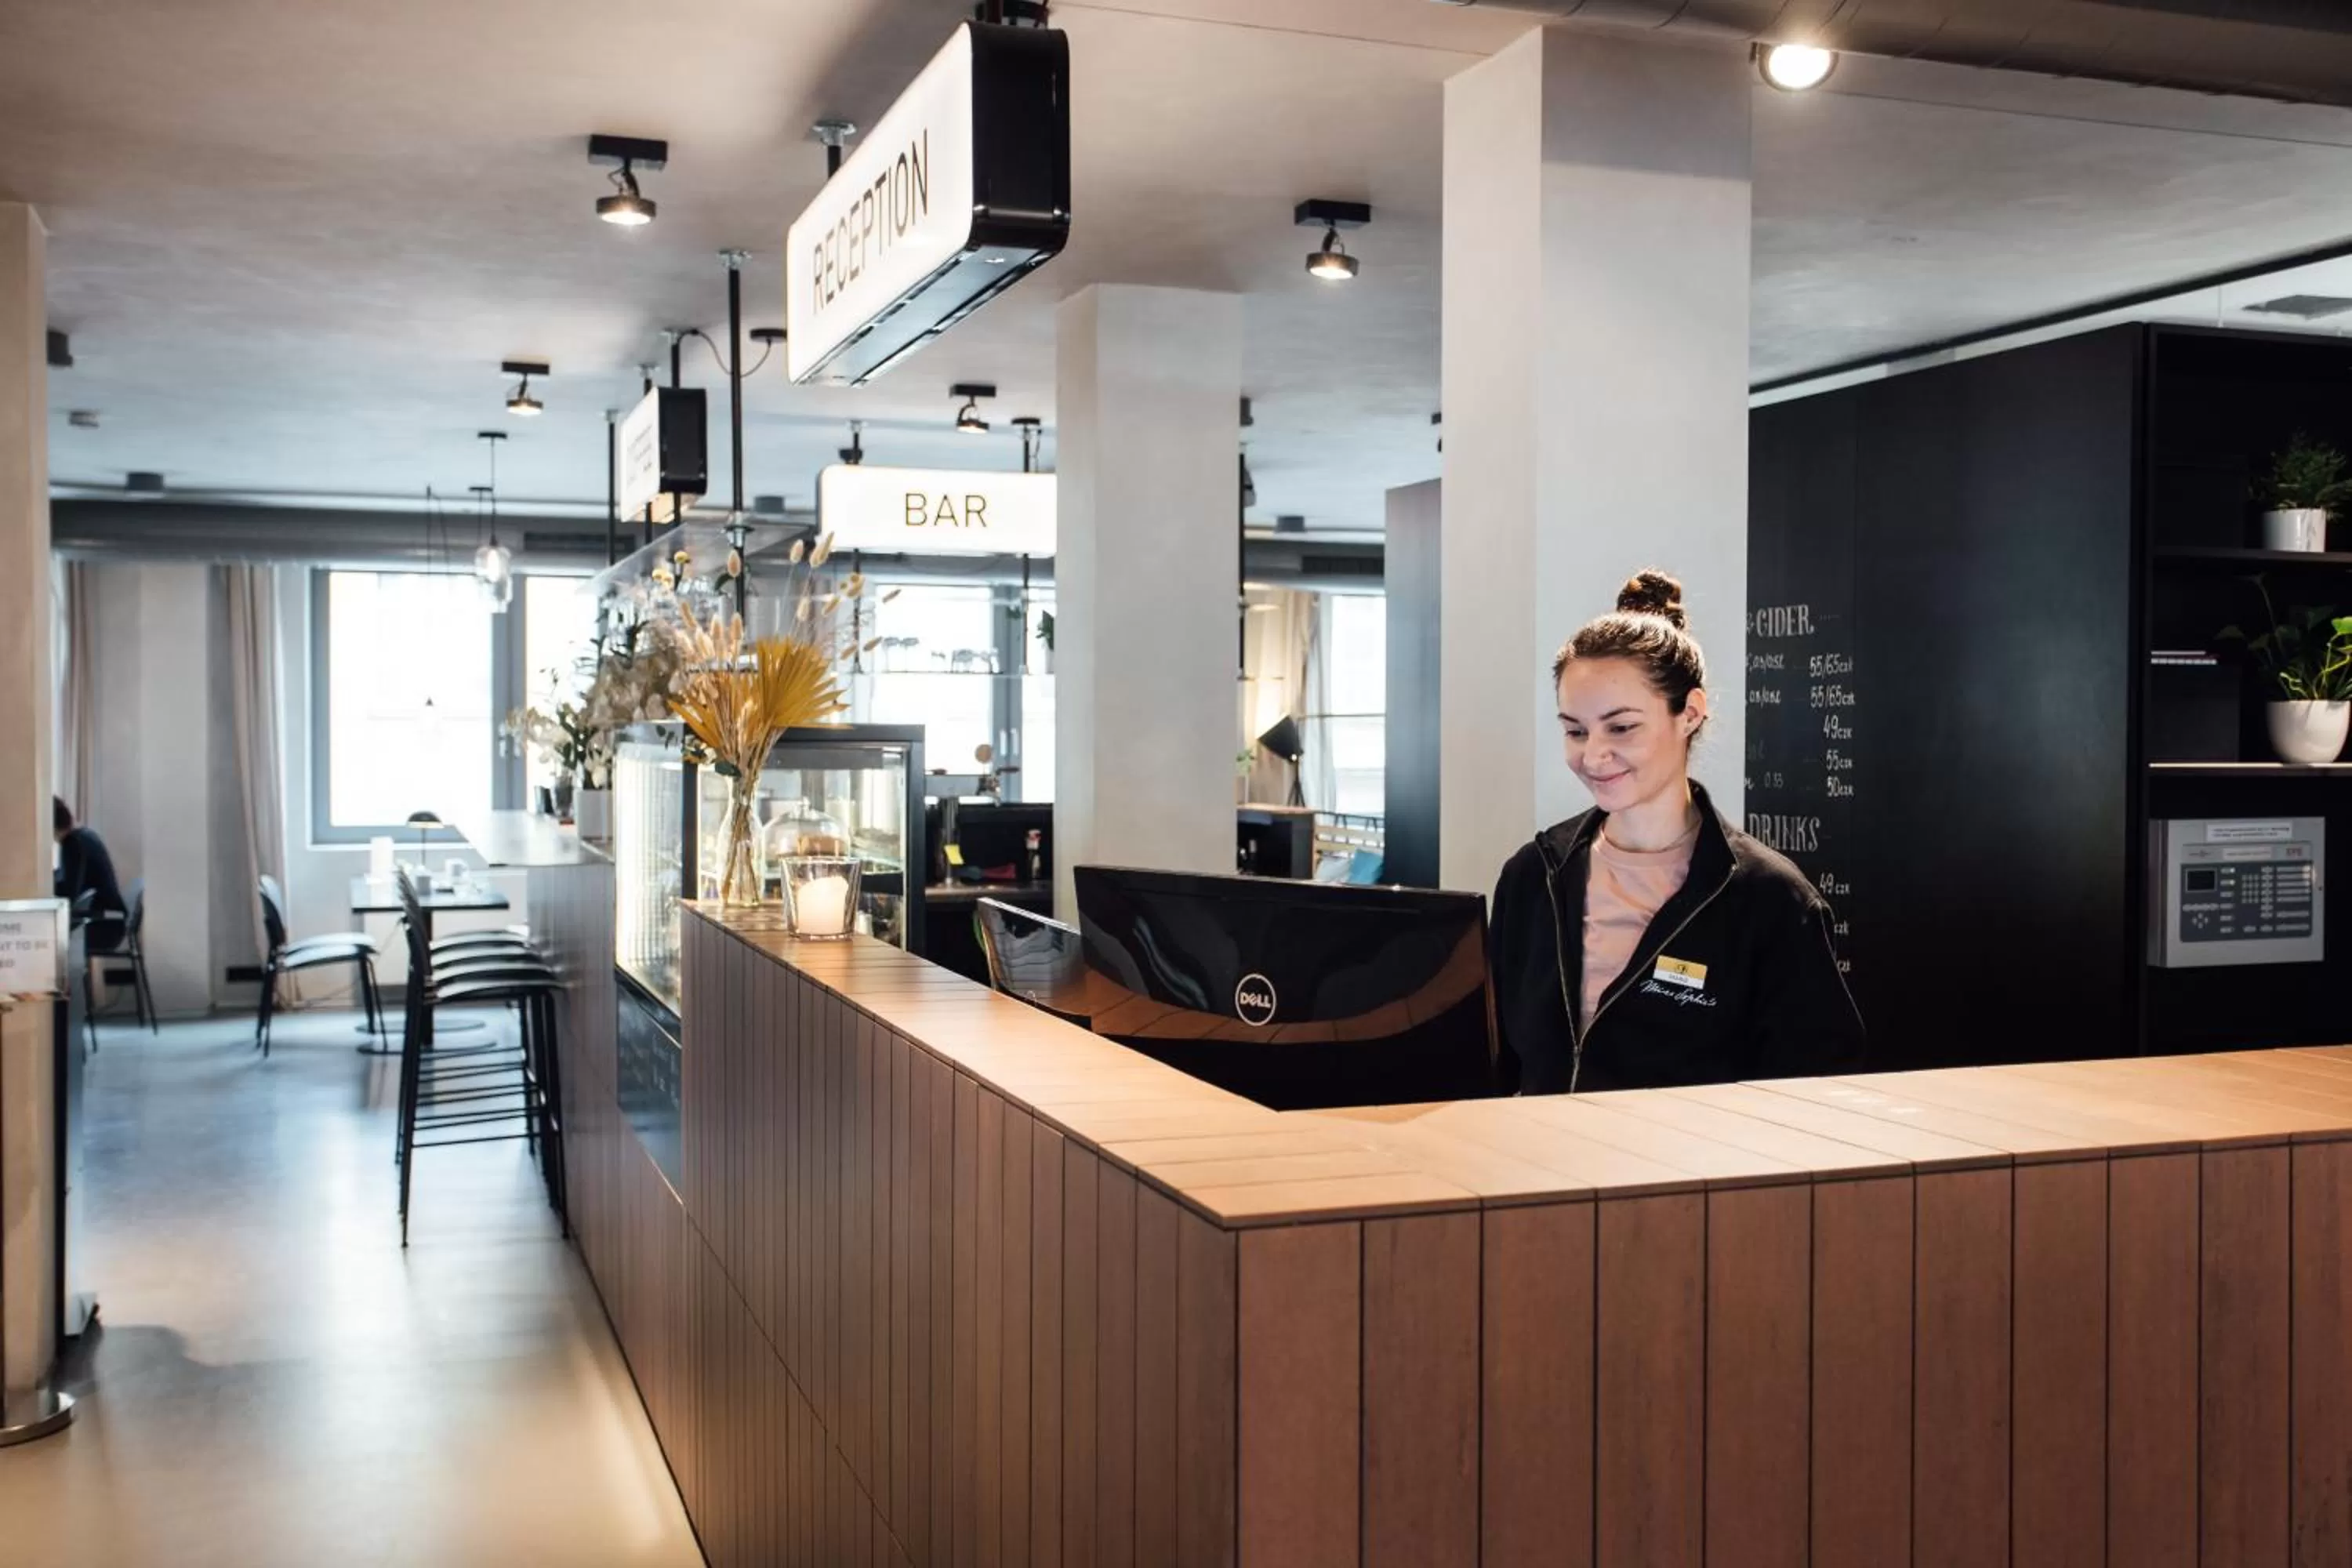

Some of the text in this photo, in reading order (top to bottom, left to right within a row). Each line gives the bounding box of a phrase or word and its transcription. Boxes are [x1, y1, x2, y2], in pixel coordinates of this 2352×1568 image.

[812, 127, 928, 315] RECEPTION
[904, 492, 988, 528] BAR
[1755, 604, 1815, 637] CIDER
[1748, 813, 1821, 852] DRINKS
[1240, 991, 1271, 1008] DELL
